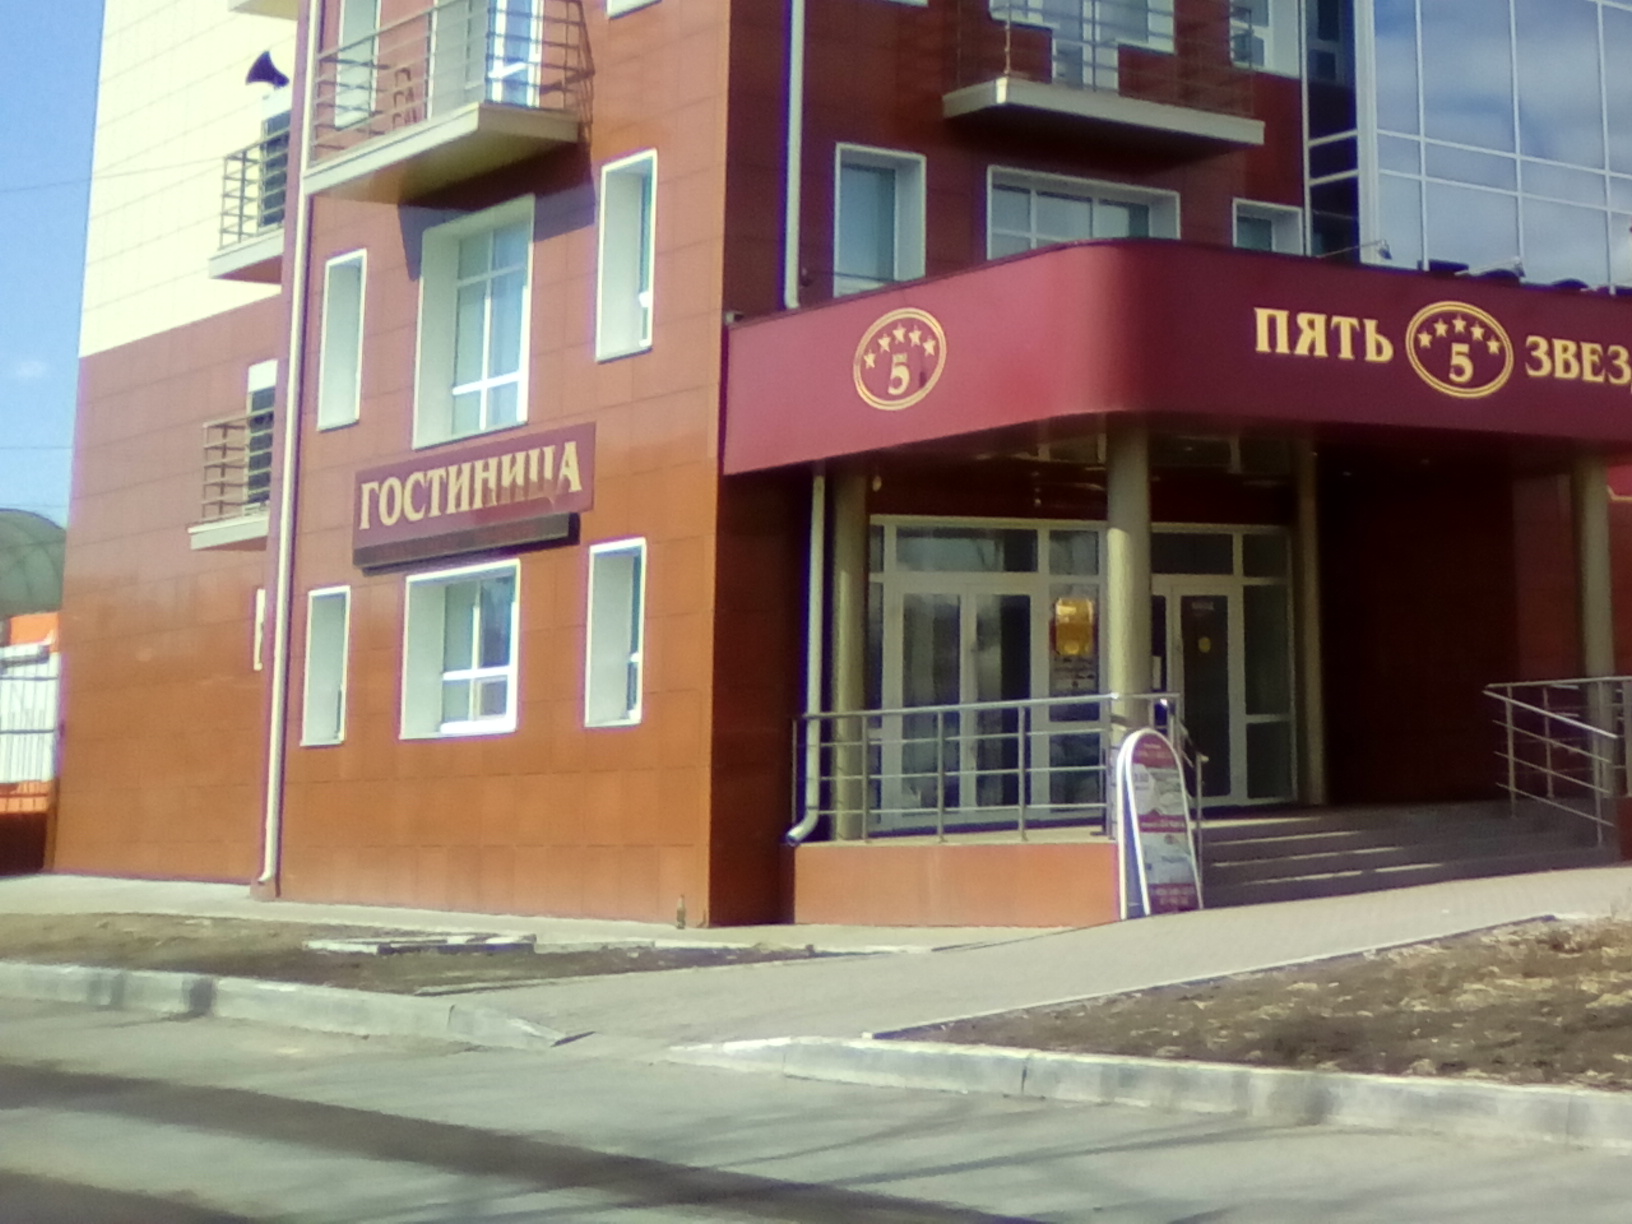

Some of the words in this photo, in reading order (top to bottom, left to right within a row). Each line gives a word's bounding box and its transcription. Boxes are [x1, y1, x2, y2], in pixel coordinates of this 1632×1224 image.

[887, 352, 910, 395] 5
[1254, 307, 1394, 364] ПЯТЬ
[1449, 342, 1474, 384] 5
[358, 440, 583, 530] ГОСТИНИЦА
